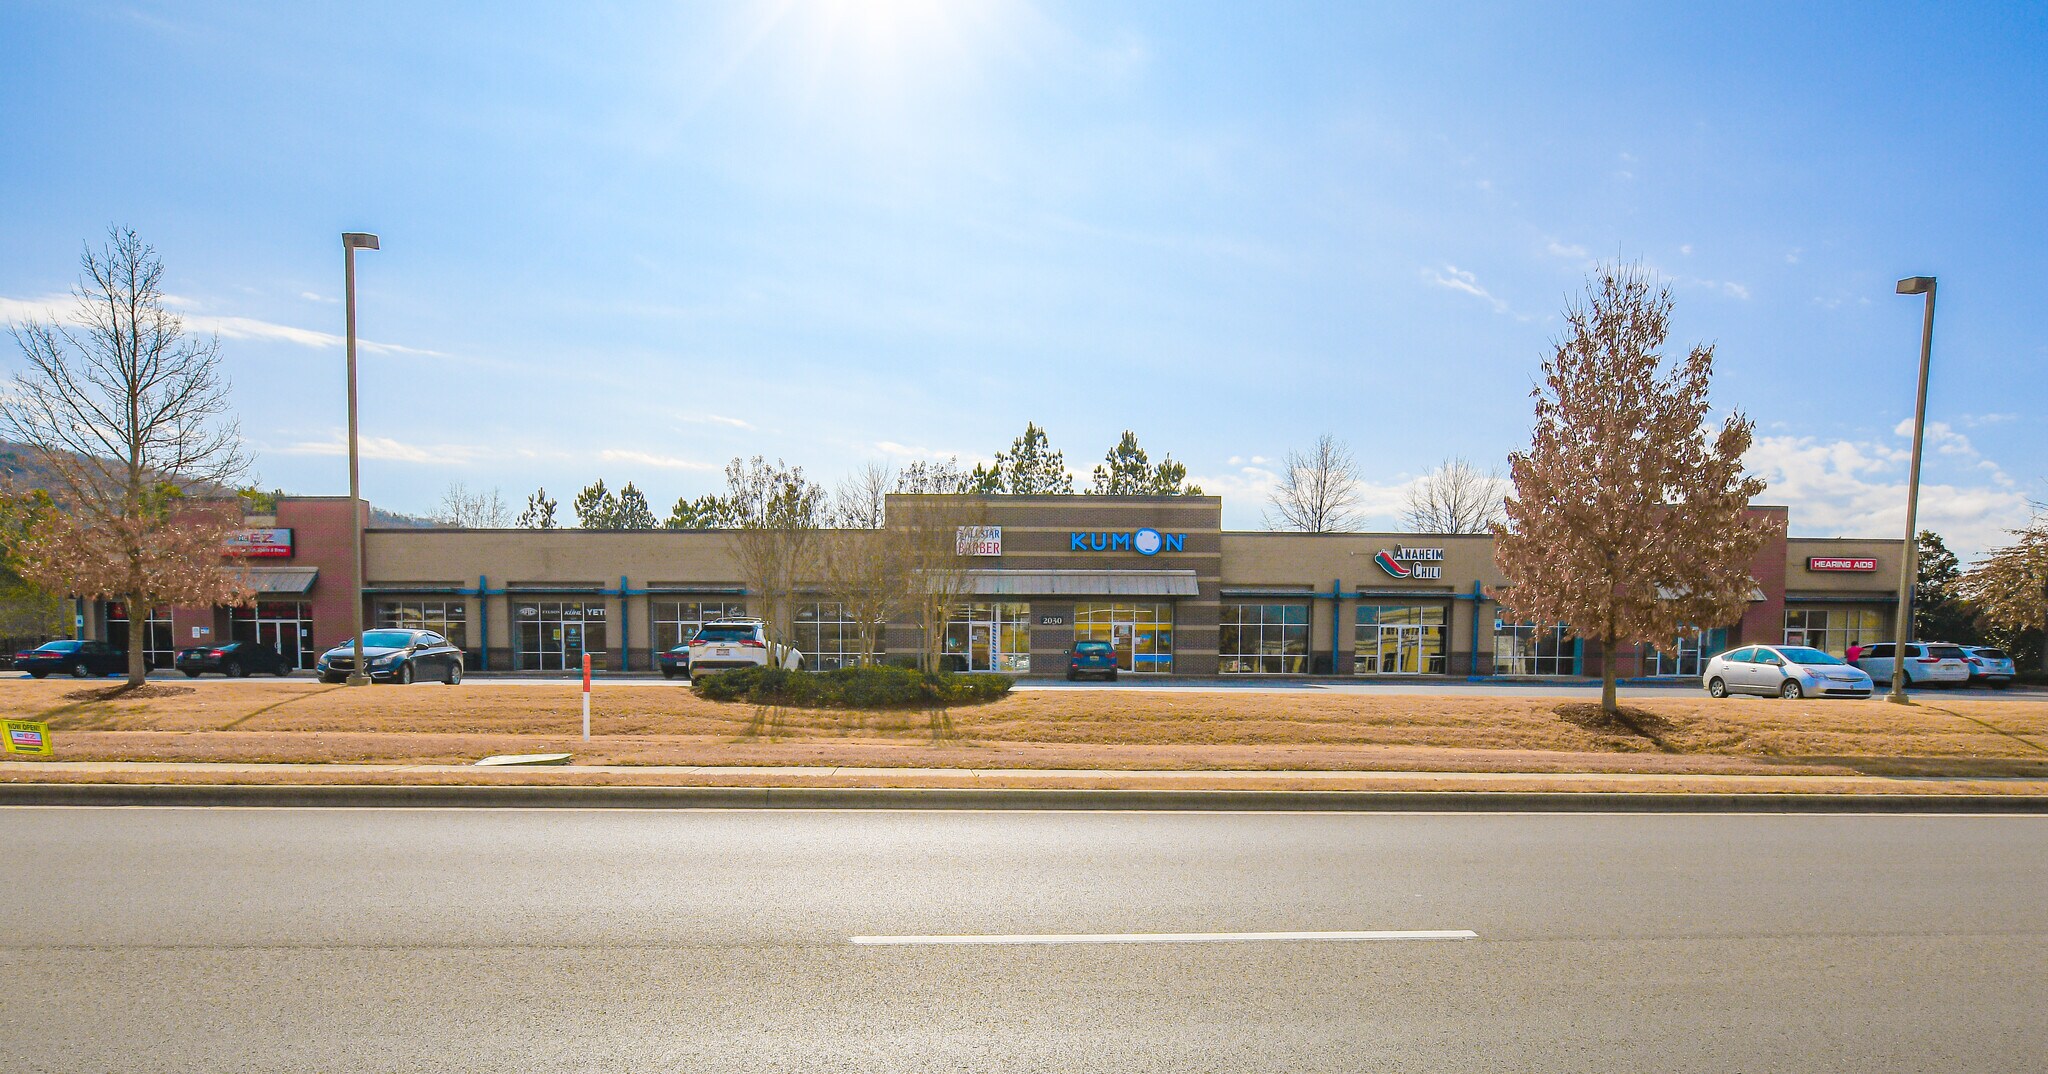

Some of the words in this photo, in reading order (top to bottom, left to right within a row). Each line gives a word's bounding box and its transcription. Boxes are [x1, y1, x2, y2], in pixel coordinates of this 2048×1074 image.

[1071, 528, 1184, 556] KUMON
[1393, 544, 1444, 560] ANAHEIM
[1413, 562, 1441, 578] CHILI
[586, 608, 606, 616] YETI
